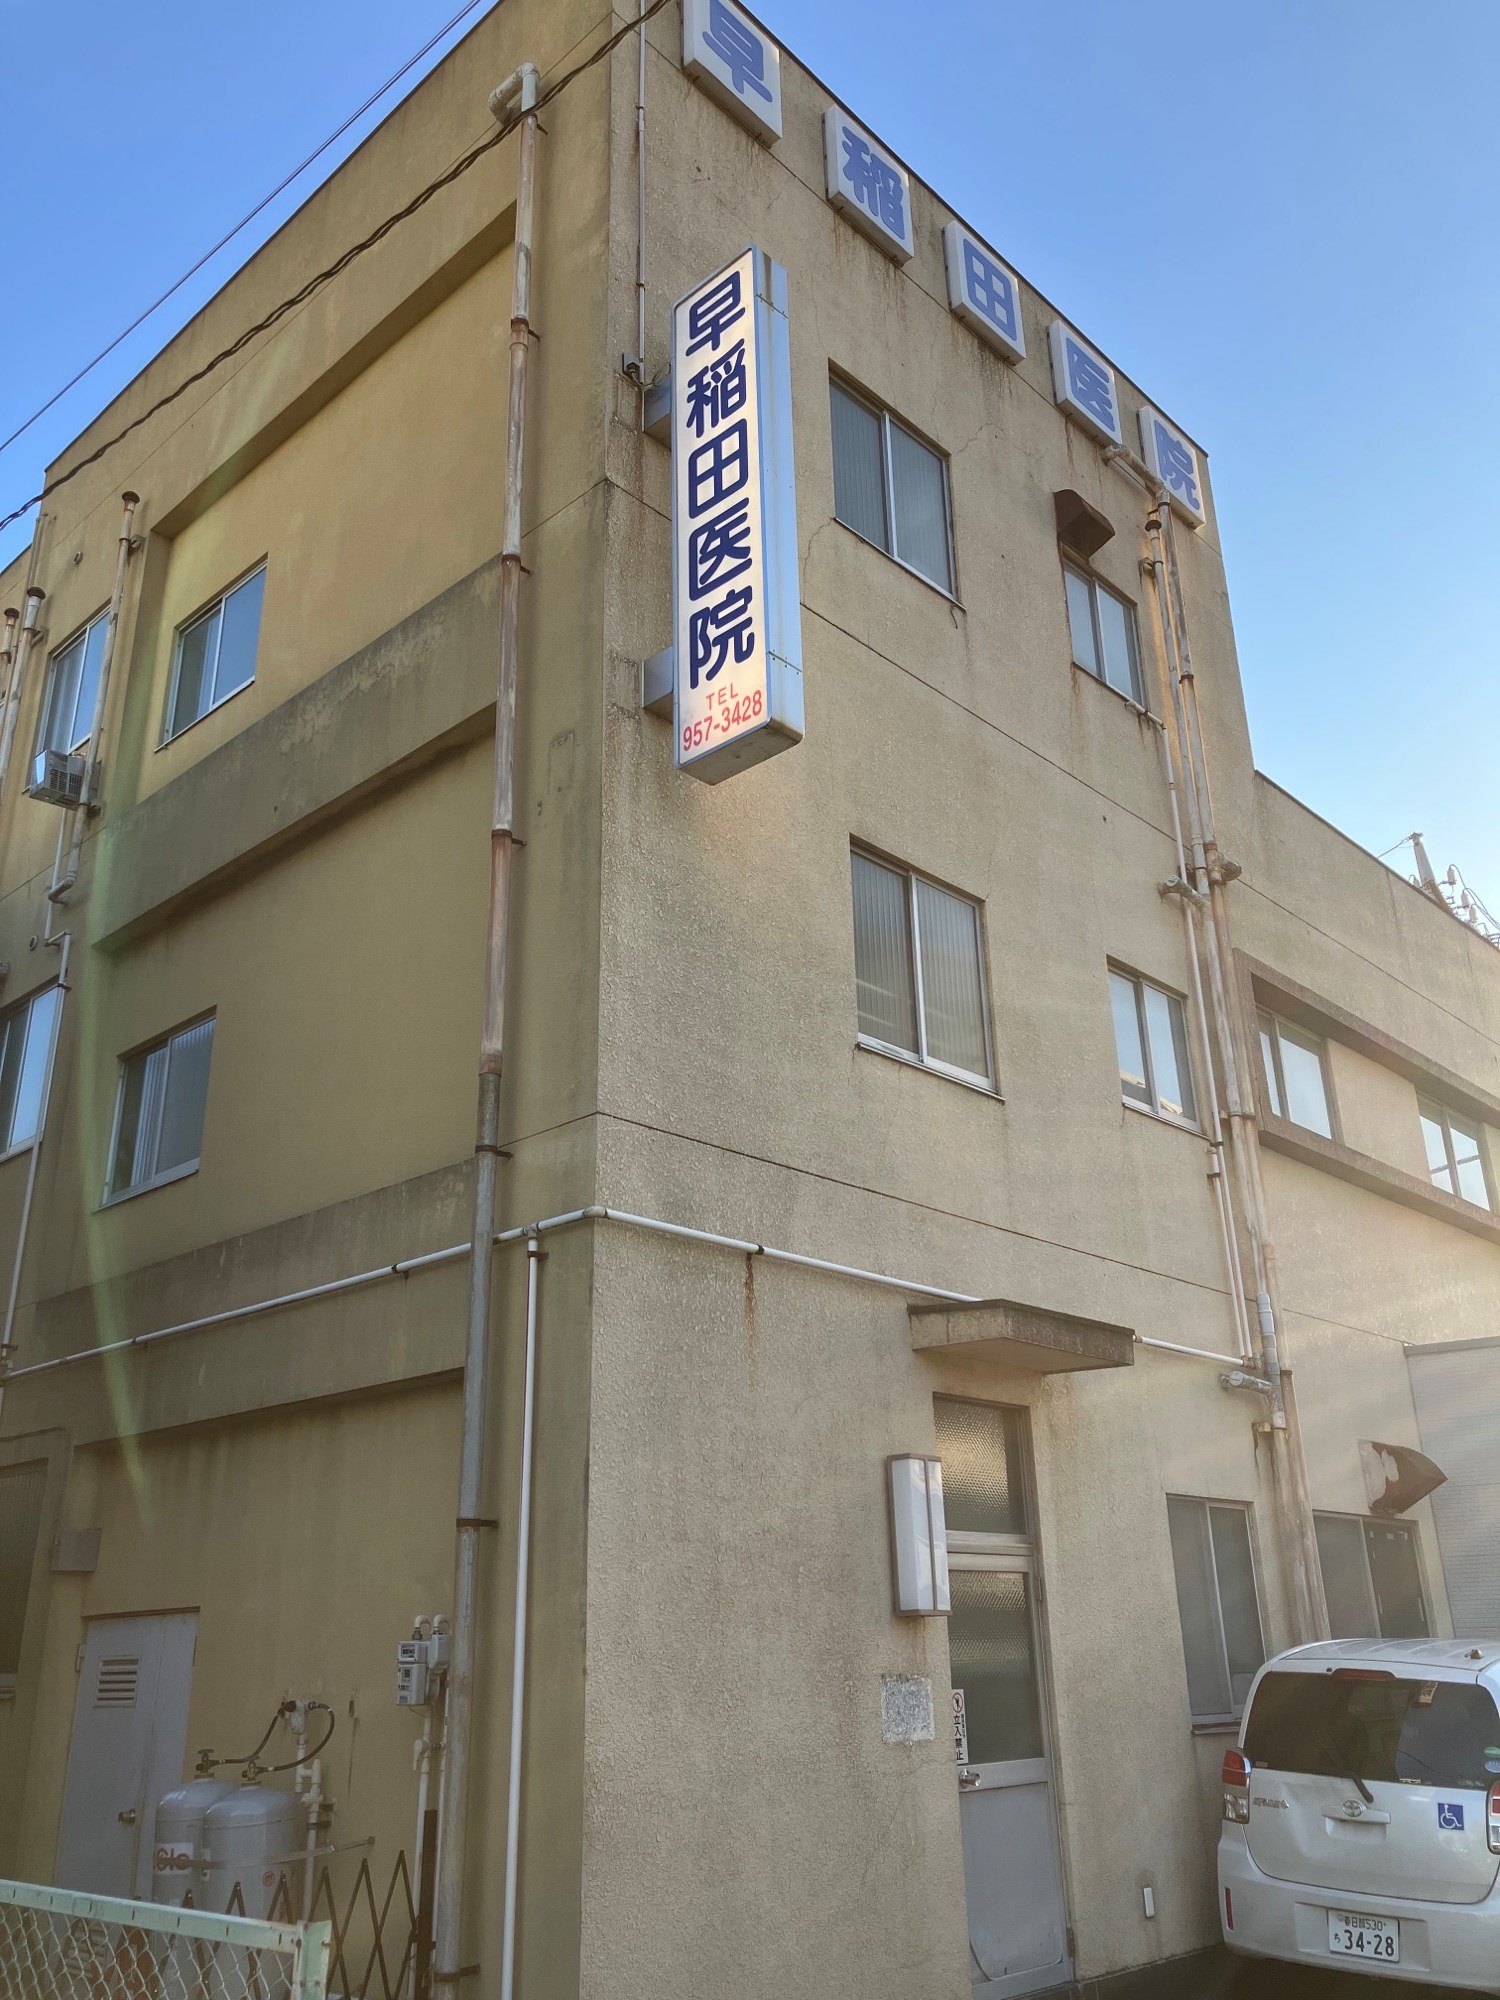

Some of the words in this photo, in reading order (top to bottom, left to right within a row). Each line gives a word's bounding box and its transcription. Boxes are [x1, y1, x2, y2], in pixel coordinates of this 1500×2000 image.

[686, 270, 755, 690] 早稲田医院
[683, 689, 762, 752] 957-3428
[705, 682, 739, 712] TEL
[953, 1714, 964, 1761] 立入禁止
[1343, 1929, 1395, 1957] 34-28
